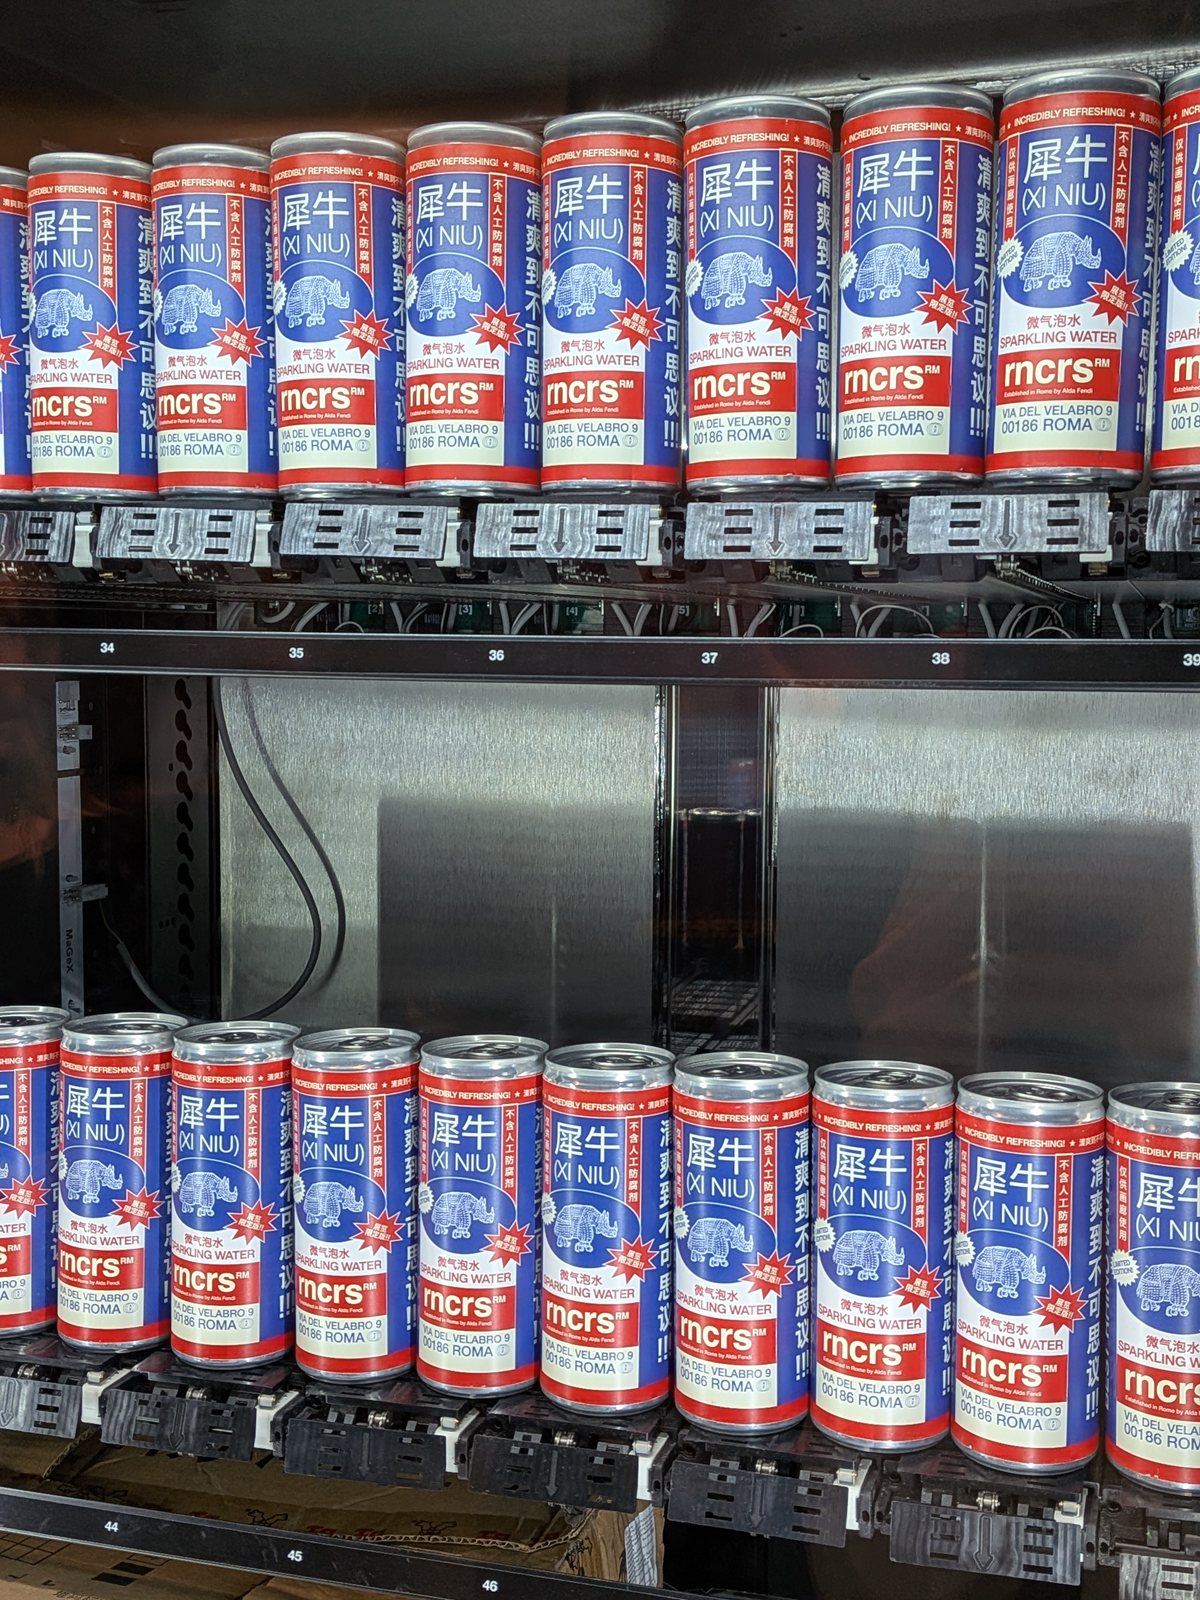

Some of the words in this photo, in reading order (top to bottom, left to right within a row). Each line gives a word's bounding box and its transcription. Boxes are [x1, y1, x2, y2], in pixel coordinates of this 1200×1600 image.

[1014, 108, 1062, 127] INCREDIBLY
[1063, 106, 1125, 117] REFRESHING!
[1024, 134, 1107, 184] 犀牛
[857, 148, 933, 198] 犀牛
[701, 159, 774, 207] 犀牛
[417, 181, 482, 224] 犀牛
[555, 173, 623, 218] 犀牛
[1022, 186, 1046, 216] (XI
[1055, 183, 1106, 211] NIU)
[283, 190, 349, 232] 犀牛
[856, 199, 878, 229] (XI
[884, 195, 933, 223] NIU)
[34, 208, 92, 247] 犀牛
[160, 201, 220, 242] 犀牛
[700, 209, 722, 238] (XI
[726, 204, 774, 232] NIU)
[416, 227, 438, 253] (XI
[440, 224, 483, 249] NIU)
[554, 221, 574, 248] (XI
[579, 218, 624, 244] NIU)
[282, 234, 304, 261] (XI
[306, 232, 351, 257] NIU)
[34, 249, 48, 275] (XI
[53, 247, 94, 272] NIU)
[159, 244, 176, 270] (XI
[180, 242, 222, 267] NIU)
[900, 340, 947, 350] WATER
[1000, 331, 1066, 349] SPARKLING
[1070, 332, 1117, 343] WATER
[746, 346, 792, 356] WATER
[456, 358, 499, 368] WATER
[596, 355, 640, 365] WATER
[199, 370, 241, 380] WATER
[327, 364, 370, 374] WATER
[70, 373, 112, 383] WATER
[1003, 407, 1016, 418] VIA
[1019, 406, 1040, 416] DEL
[1045, 406, 1102, 415] VELABRO
[1106, 406, 1112, 415] 9
[877, 424, 924, 436] ROMA
[1002, 419, 1038, 433] 00186
[1043, 419, 1092, 431] ROMA
[438, 436, 480, 447] ROMA
[576, 436, 620, 447] ROMA
[727, 429, 772, 442] ROMA
[55, 446, 95, 457] ROMA
[184, 445, 224, 455] ROMA
[310, 440, 353, 451] ROMA
[100, 643, 114, 653] 34
[289, 648, 304, 658] 35
[489, 650, 504, 661] 36
[702, 652, 718, 663] 37
[932, 653, 950, 664] 38
[1183, 654, 1200, 666] 39
[67, 1085, 125, 1120] 犀牛
[180, 1095, 239, 1132] 犀牛
[303, 1104, 363, 1140] 犀牛
[66, 1119, 80, 1140] (XI
[86, 1120, 125, 1148] NIU)
[432, 1112, 494, 1150] 犀牛
[180, 1130, 202, 1152] (XI
[200, 1131, 239, 1160] NIU)
[555, 1122, 619, 1162] 犀牛
[302, 1139, 319, 1162] (XI
[325, 1139, 364, 1169] NIU)
[687, 1134, 753, 1175] 犀牛
[1124, 1143, 1170, 1160] INCREDIBLY
[432, 1148, 449, 1171] (XI
[455, 1149, 496, 1179] NIU)
[834, 1144, 906, 1186] 犀牛
[554, 1159, 572, 1182] (XI
[578, 1162, 620, 1191] NIU)
[974, 1157, 1049, 1202] 犀牛
[687, 1172, 705, 1195] (XI
[712, 1176, 756, 1204] NIU)
[833, 1183, 853, 1206] (XI
[860, 1186, 906, 1216] NIU)
[973, 1197, 993, 1220] (XI
[1002, 1204, 1048, 1232] NIU)
[100, 1236, 139, 1245] WATER
[215, 1250, 255, 1259] WATER
[342, 1260, 382, 1270] WATER
[471, 1273, 511, 1283] WATER
[594, 1289, 635, 1298] WATER
[83, 1303, 121, 1314] ROMA
[730, 1304, 772, 1314] WATER
[198, 1319, 237, 1330] ROMA
[879, 1318, 921, 1329] WATER
[326, 1332, 364, 1342] ROMA
[958, 1319, 1015, 1348] SPARKLING
[1019, 1338, 1063, 1350] WATER
[453, 1345, 495, 1356] ROMA
[1118, 1340, 1186, 1368] SPARKLING
[575, 1361, 617, 1374] ROMA
[712, 1378, 755, 1392] ROMA
[859, 1394, 903, 1408] ROMA
[997, 1414, 1042, 1430] ROMA
[1124, 1410, 1139, 1424] VIA
[1142, 1417, 1163, 1431] DEL
[1123, 1424, 1162, 1445] 00186
[105, 1521, 118, 1532] 44
[288, 1550, 302, 1561] 45
[483, 1580, 497, 1592] 46
